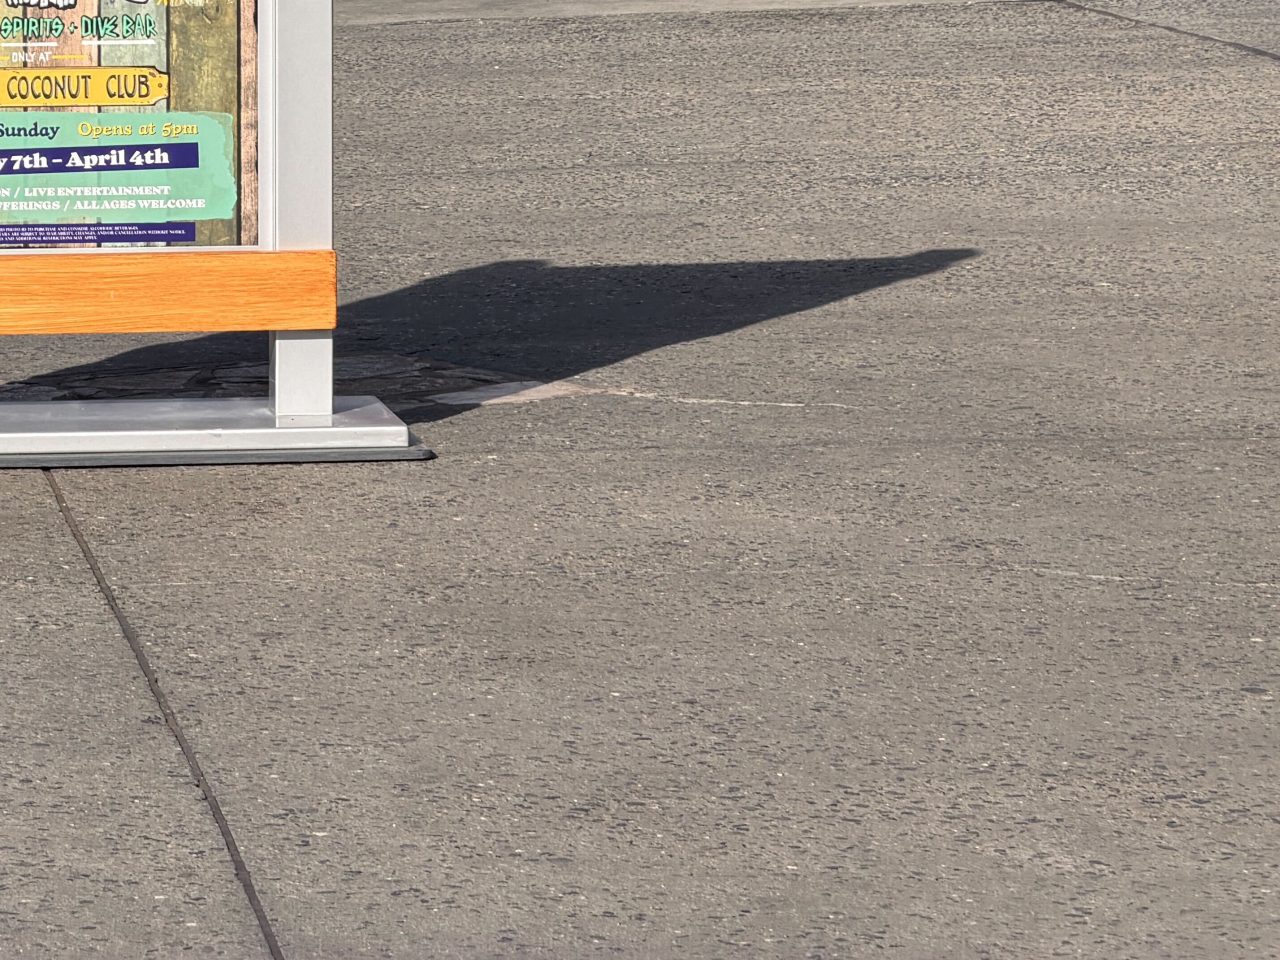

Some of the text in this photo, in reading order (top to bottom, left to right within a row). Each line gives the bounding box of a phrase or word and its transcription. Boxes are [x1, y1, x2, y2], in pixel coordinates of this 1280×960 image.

[0, 15, 65, 39] SPIRITS
[81, 14, 120, 39] DIVE
[122, 12, 158, 38] BAR
[11, 51, 52, 64] ONLY AT
[6, 75, 92, 100] COCONUT
[106, 74, 151, 100] CLUB
[77, 121, 133, 139] Opens
[138, 123, 157, 137] at
[162, 122, 199, 138] 5pm
[10, 152, 48, 170] 7th
[65, 149, 127, 169] April
[129, 147, 170, 166] 4th
[24, 186, 58, 197] LIVE
[58, 185, 172, 197] ENTERTAINMENT
[73, 200, 99, 210] ALL
[99, 199, 137, 209] AGES
[137, 198, 206, 209] WELCOME
